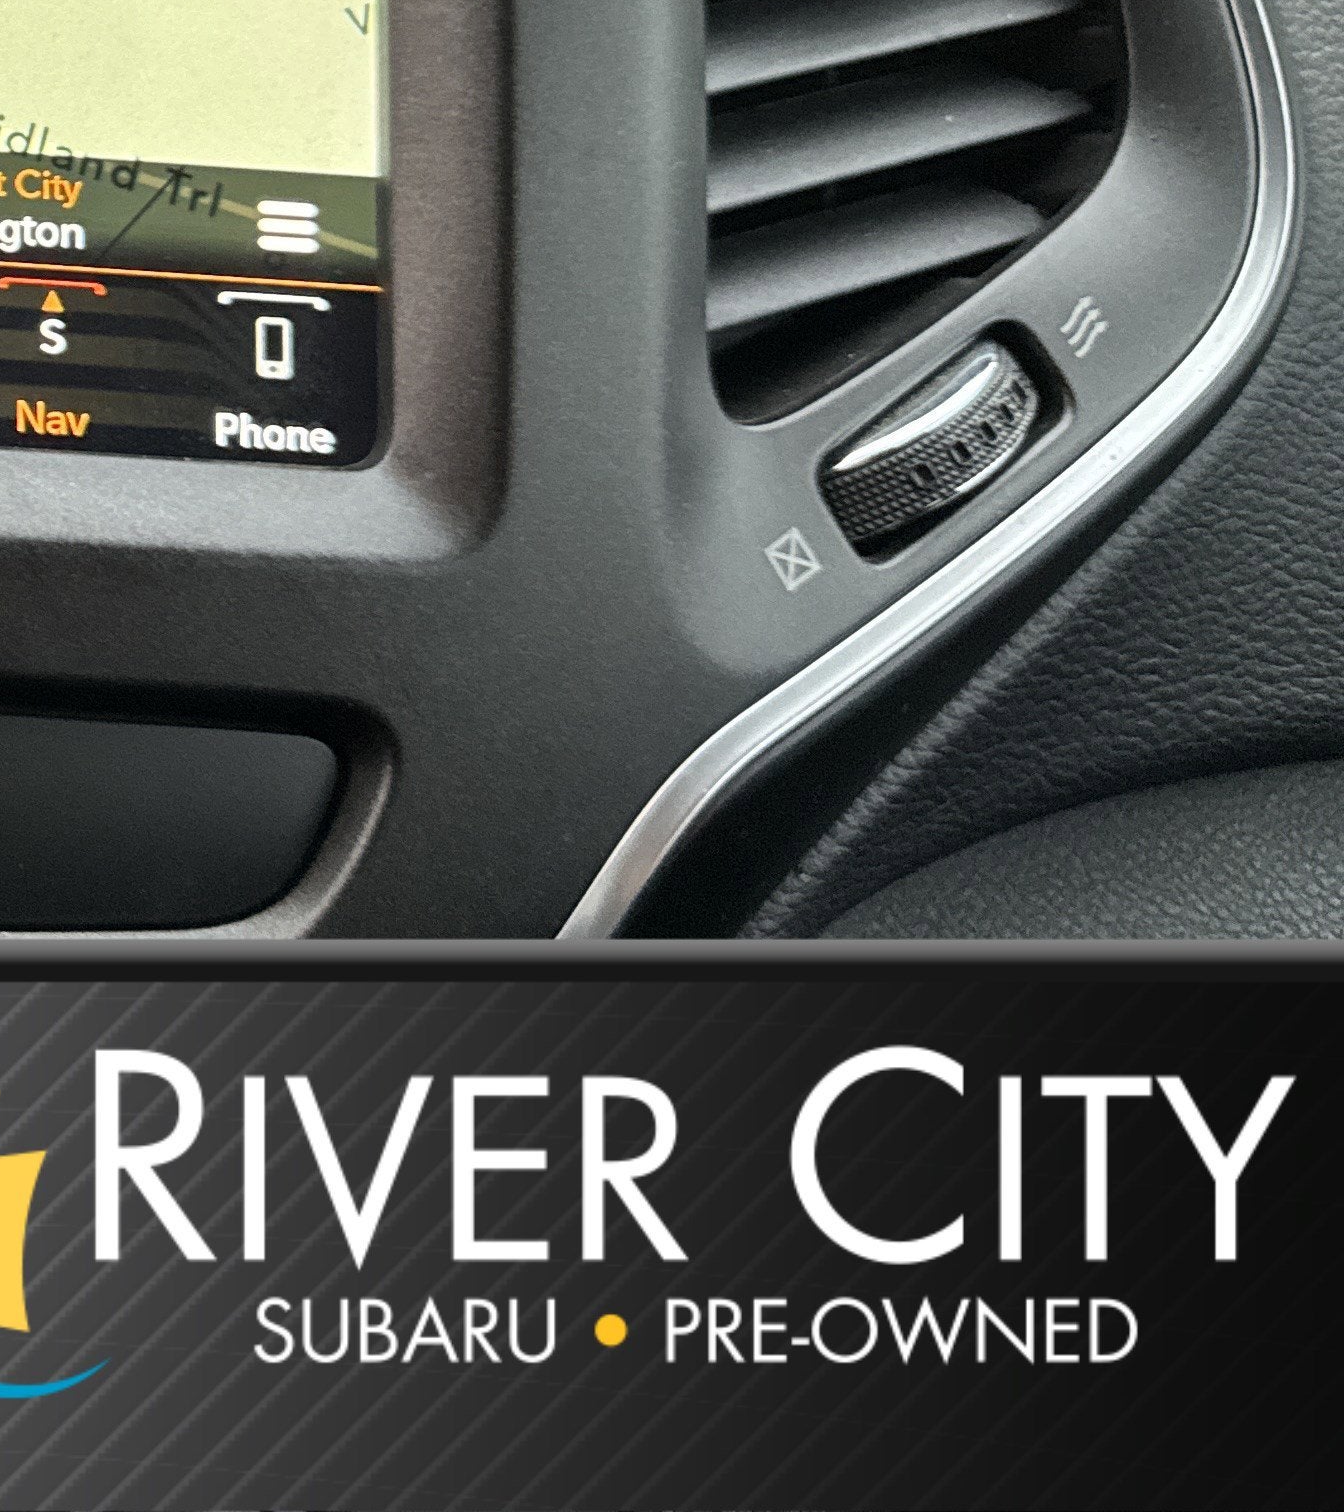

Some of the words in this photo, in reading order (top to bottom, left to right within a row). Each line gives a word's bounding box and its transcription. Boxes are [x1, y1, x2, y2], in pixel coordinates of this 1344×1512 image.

[12, 166, 84, 210] City
[165, 167, 224, 218] Trl
[38, 317, 69, 356] S
[14, 399, 91, 437] Nav
[213, 410, 337, 455] Phone
